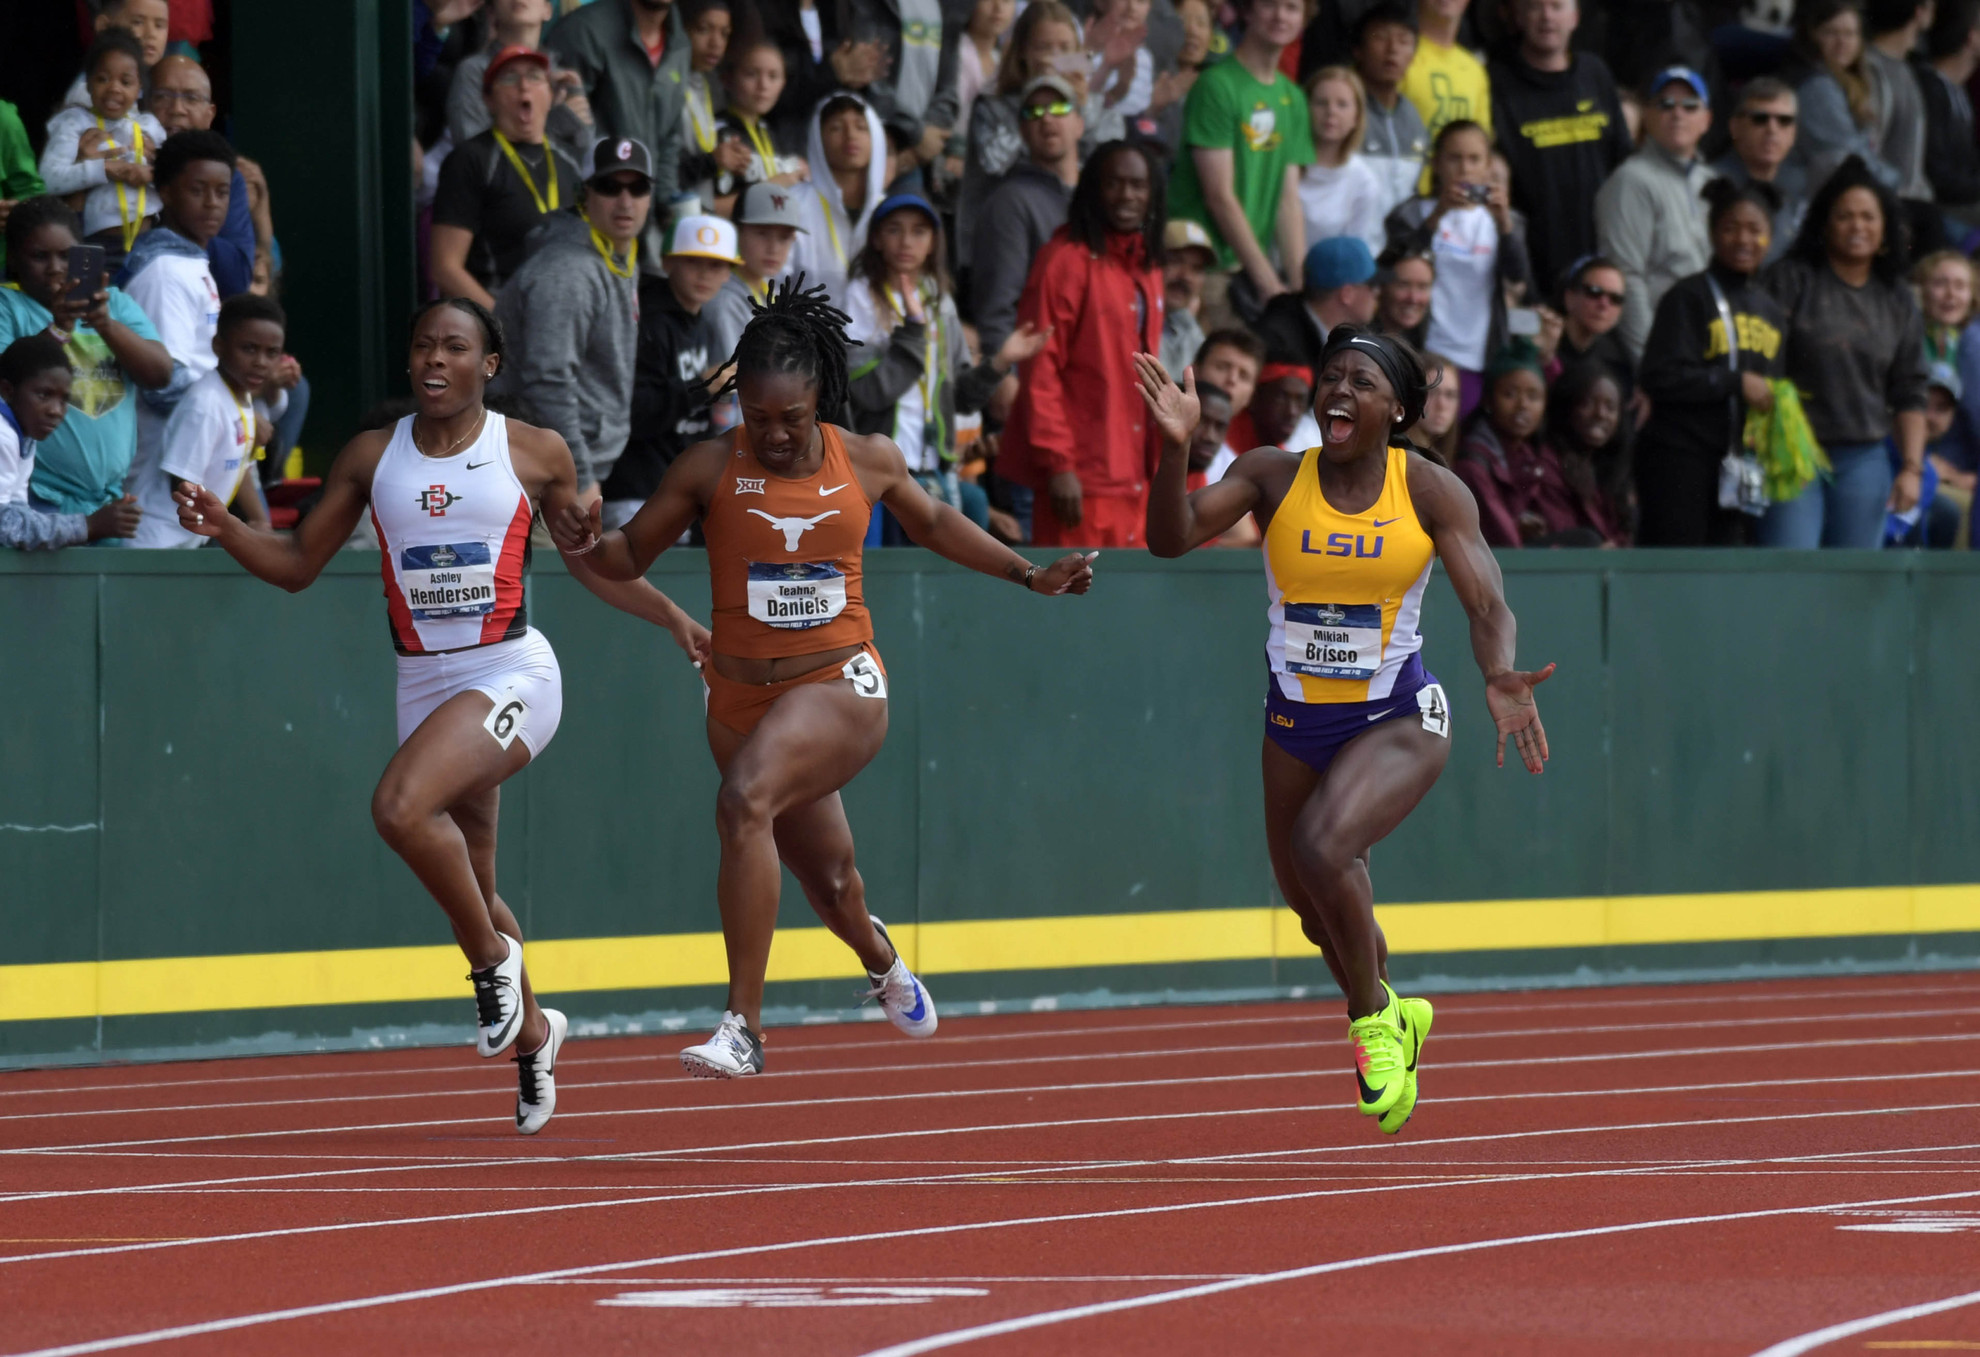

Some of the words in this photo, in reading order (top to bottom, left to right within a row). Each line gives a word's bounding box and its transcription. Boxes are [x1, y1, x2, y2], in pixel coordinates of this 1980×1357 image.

[696, 226, 719, 245] O
[1301, 530, 1384, 558] LSU
[430, 572, 462, 584] Ashley
[409, 585, 491, 605] Henderson
[779, 586, 816, 596] Teahna
[767, 597, 829, 617] Daniels
[1313, 629, 1349, 643] Mikiah
[1305, 642, 1358, 663] Brisco
[850, 655, 879, 695] 5
[1428, 687, 1446, 731] 4
[493, 701, 524, 739] 6
[1270, 711, 1295, 728] LSU
